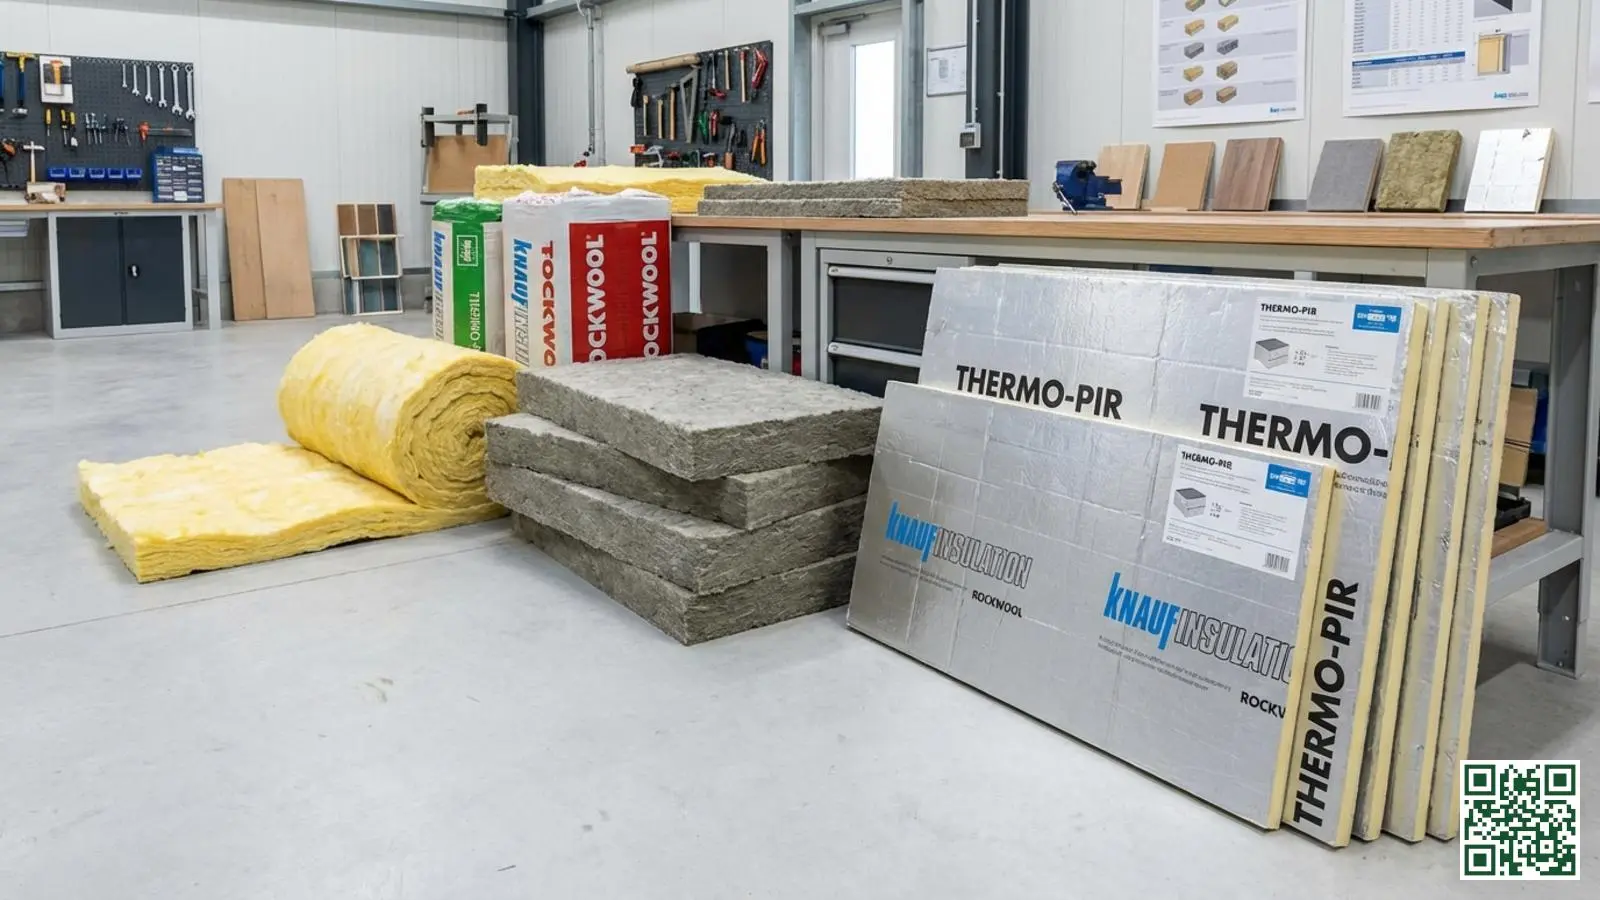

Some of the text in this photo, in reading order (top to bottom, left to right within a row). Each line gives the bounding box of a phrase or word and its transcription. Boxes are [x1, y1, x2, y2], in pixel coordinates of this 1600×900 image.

[956, 364, 1123, 420] THERMO-PIR
[1200, 403, 1388, 464] THERMO-
[932, 527, 1034, 589] INSULATION
[1292, 578, 1359, 827] THERMO-PIR
